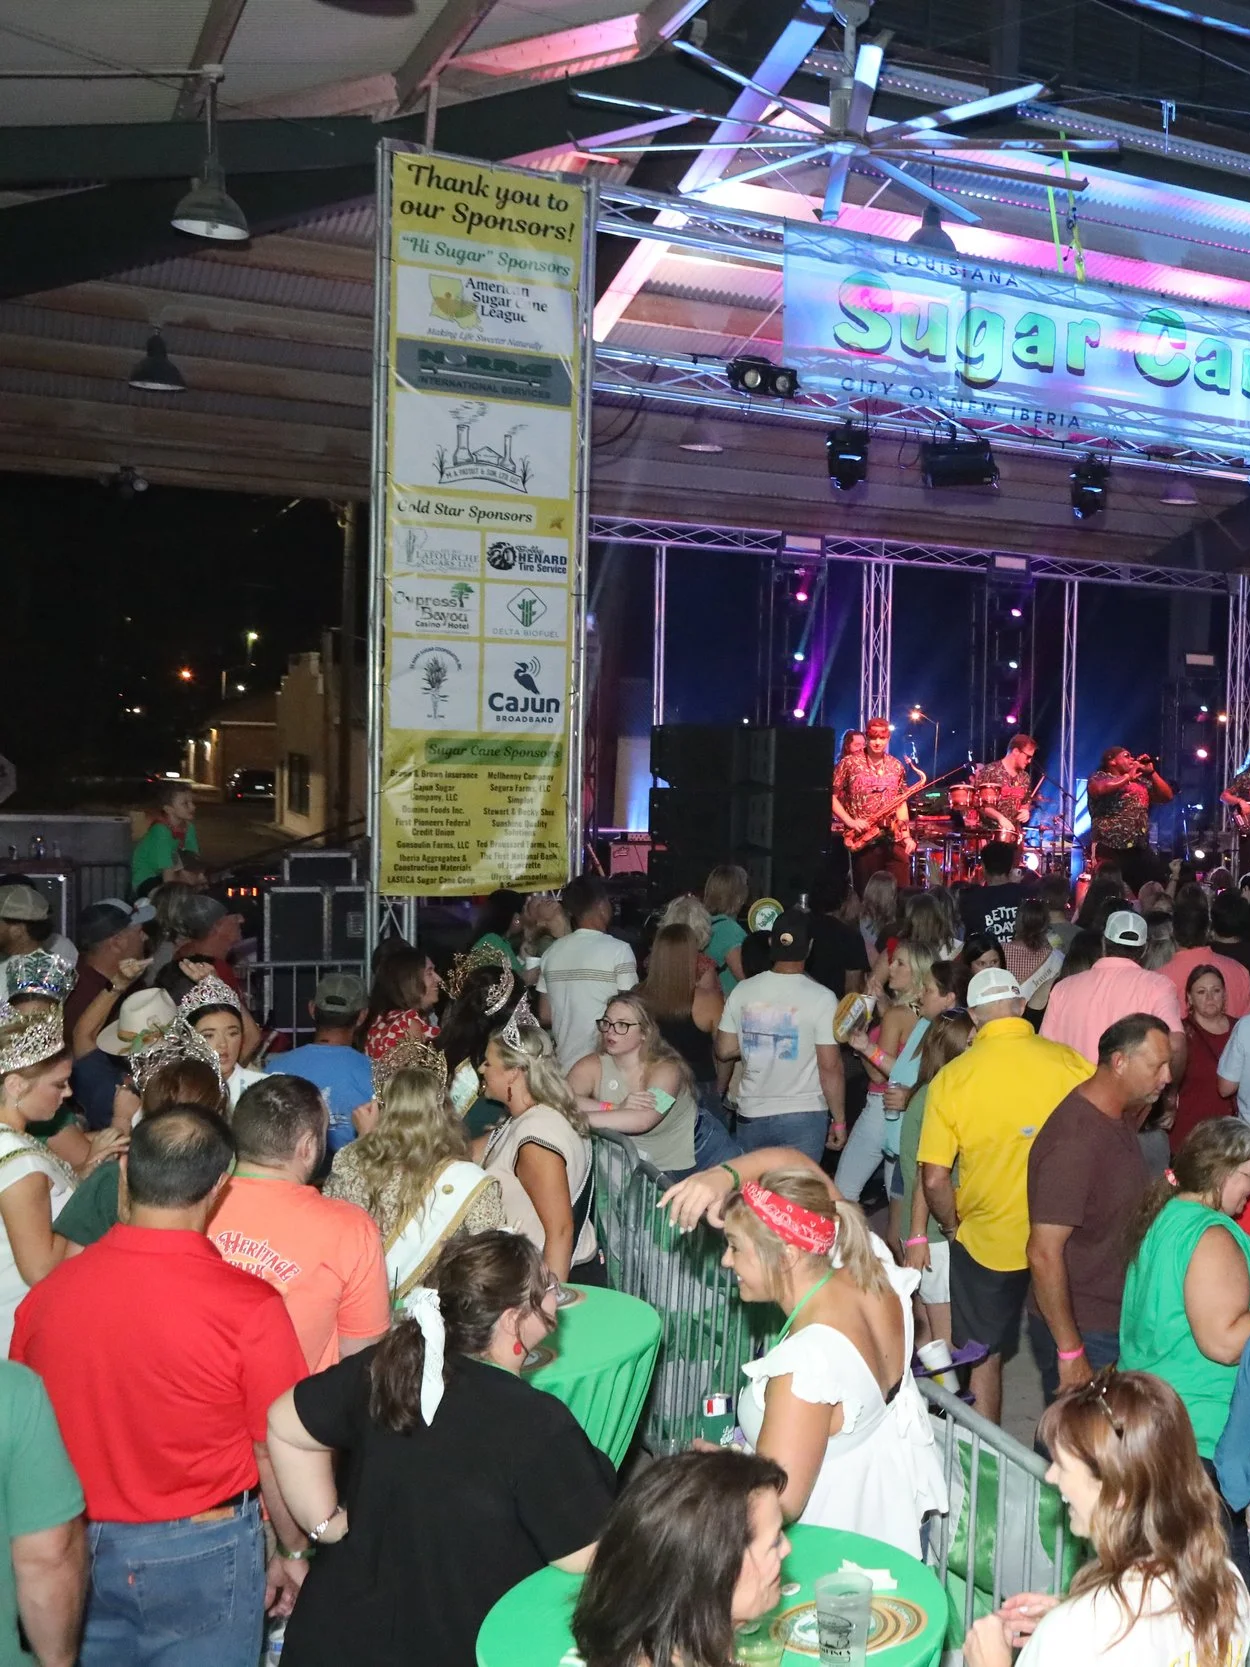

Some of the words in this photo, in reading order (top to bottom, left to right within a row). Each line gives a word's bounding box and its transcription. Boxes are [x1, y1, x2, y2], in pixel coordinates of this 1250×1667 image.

[408, 164, 489, 198] Thank
[495, 186, 540, 210] you
[548, 193, 568, 212] to
[400, 200, 445, 219] our
[452, 202, 575, 242] Sponsors!
[497, 252, 570, 276] Sponsors
[893, 252, 1019, 288] LOUISIANA
[465, 277, 530, 297] Amerin
[472, 291, 512, 308] Sugar
[515, 300, 549, 312] Cne
[833, 270, 1100, 390] Sugar
[841, 377, 895, 397] CITY
[910, 385, 942, 408] OF
[950, 397, 997, 417] NEW
[1011, 407, 1082, 430] IBERIA
[434, 502, 465, 516] Star
[468, 505, 533, 524] Sponsors
[518, 553, 568, 566] HENARD
[518, 562, 535, 572] Tire
[536, 564, 567, 574] Service
[420, 606, 468, 626] Bayou
[415, 620, 441, 628] Casino
[448, 622, 470, 630] Hotel
[523, 630, 559, 638] BIOFUEL
[496, 715, 554, 724] BROADBAND
[428, 743, 468, 760] Sugar
[470, 744, 501, 756] Cane
[504, 745, 560, 760] Sponsos
[421, 770, 444, 778] Brown
[445, 770, 478, 778] Insurance
[414, 782, 433, 792] Cajun
[434, 783, 455, 792] Sugar
[490, 784, 514, 793] Segura
[446, 793, 458, 802] LLC
[430, 806, 450, 814] Foods
[452, 806, 465, 814] Inc.
[483, 808, 510, 816] Stewart
[395, 818, 412, 826] First
[413, 818, 444, 826] Pioneers
[446, 818, 471, 826] Federal
[412, 828, 433, 836] Credit
[435, 828, 455, 836] Union
[432, 841, 456, 850] Farms,
[458, 841, 470, 849] LLC
[476, 840, 488, 848] Ted
[400, 854, 420, 862] Iberia
[422, 854, 460, 863] Aggregates
[462, 854, 467, 862] &
[540, 852, 558, 860] Bank
[394, 863, 438, 872] Construction
[440, 864, 472, 872] Materials
[416, 876, 438, 885] Sugar
[216, 1230, 300, 1282] HERITAGE
